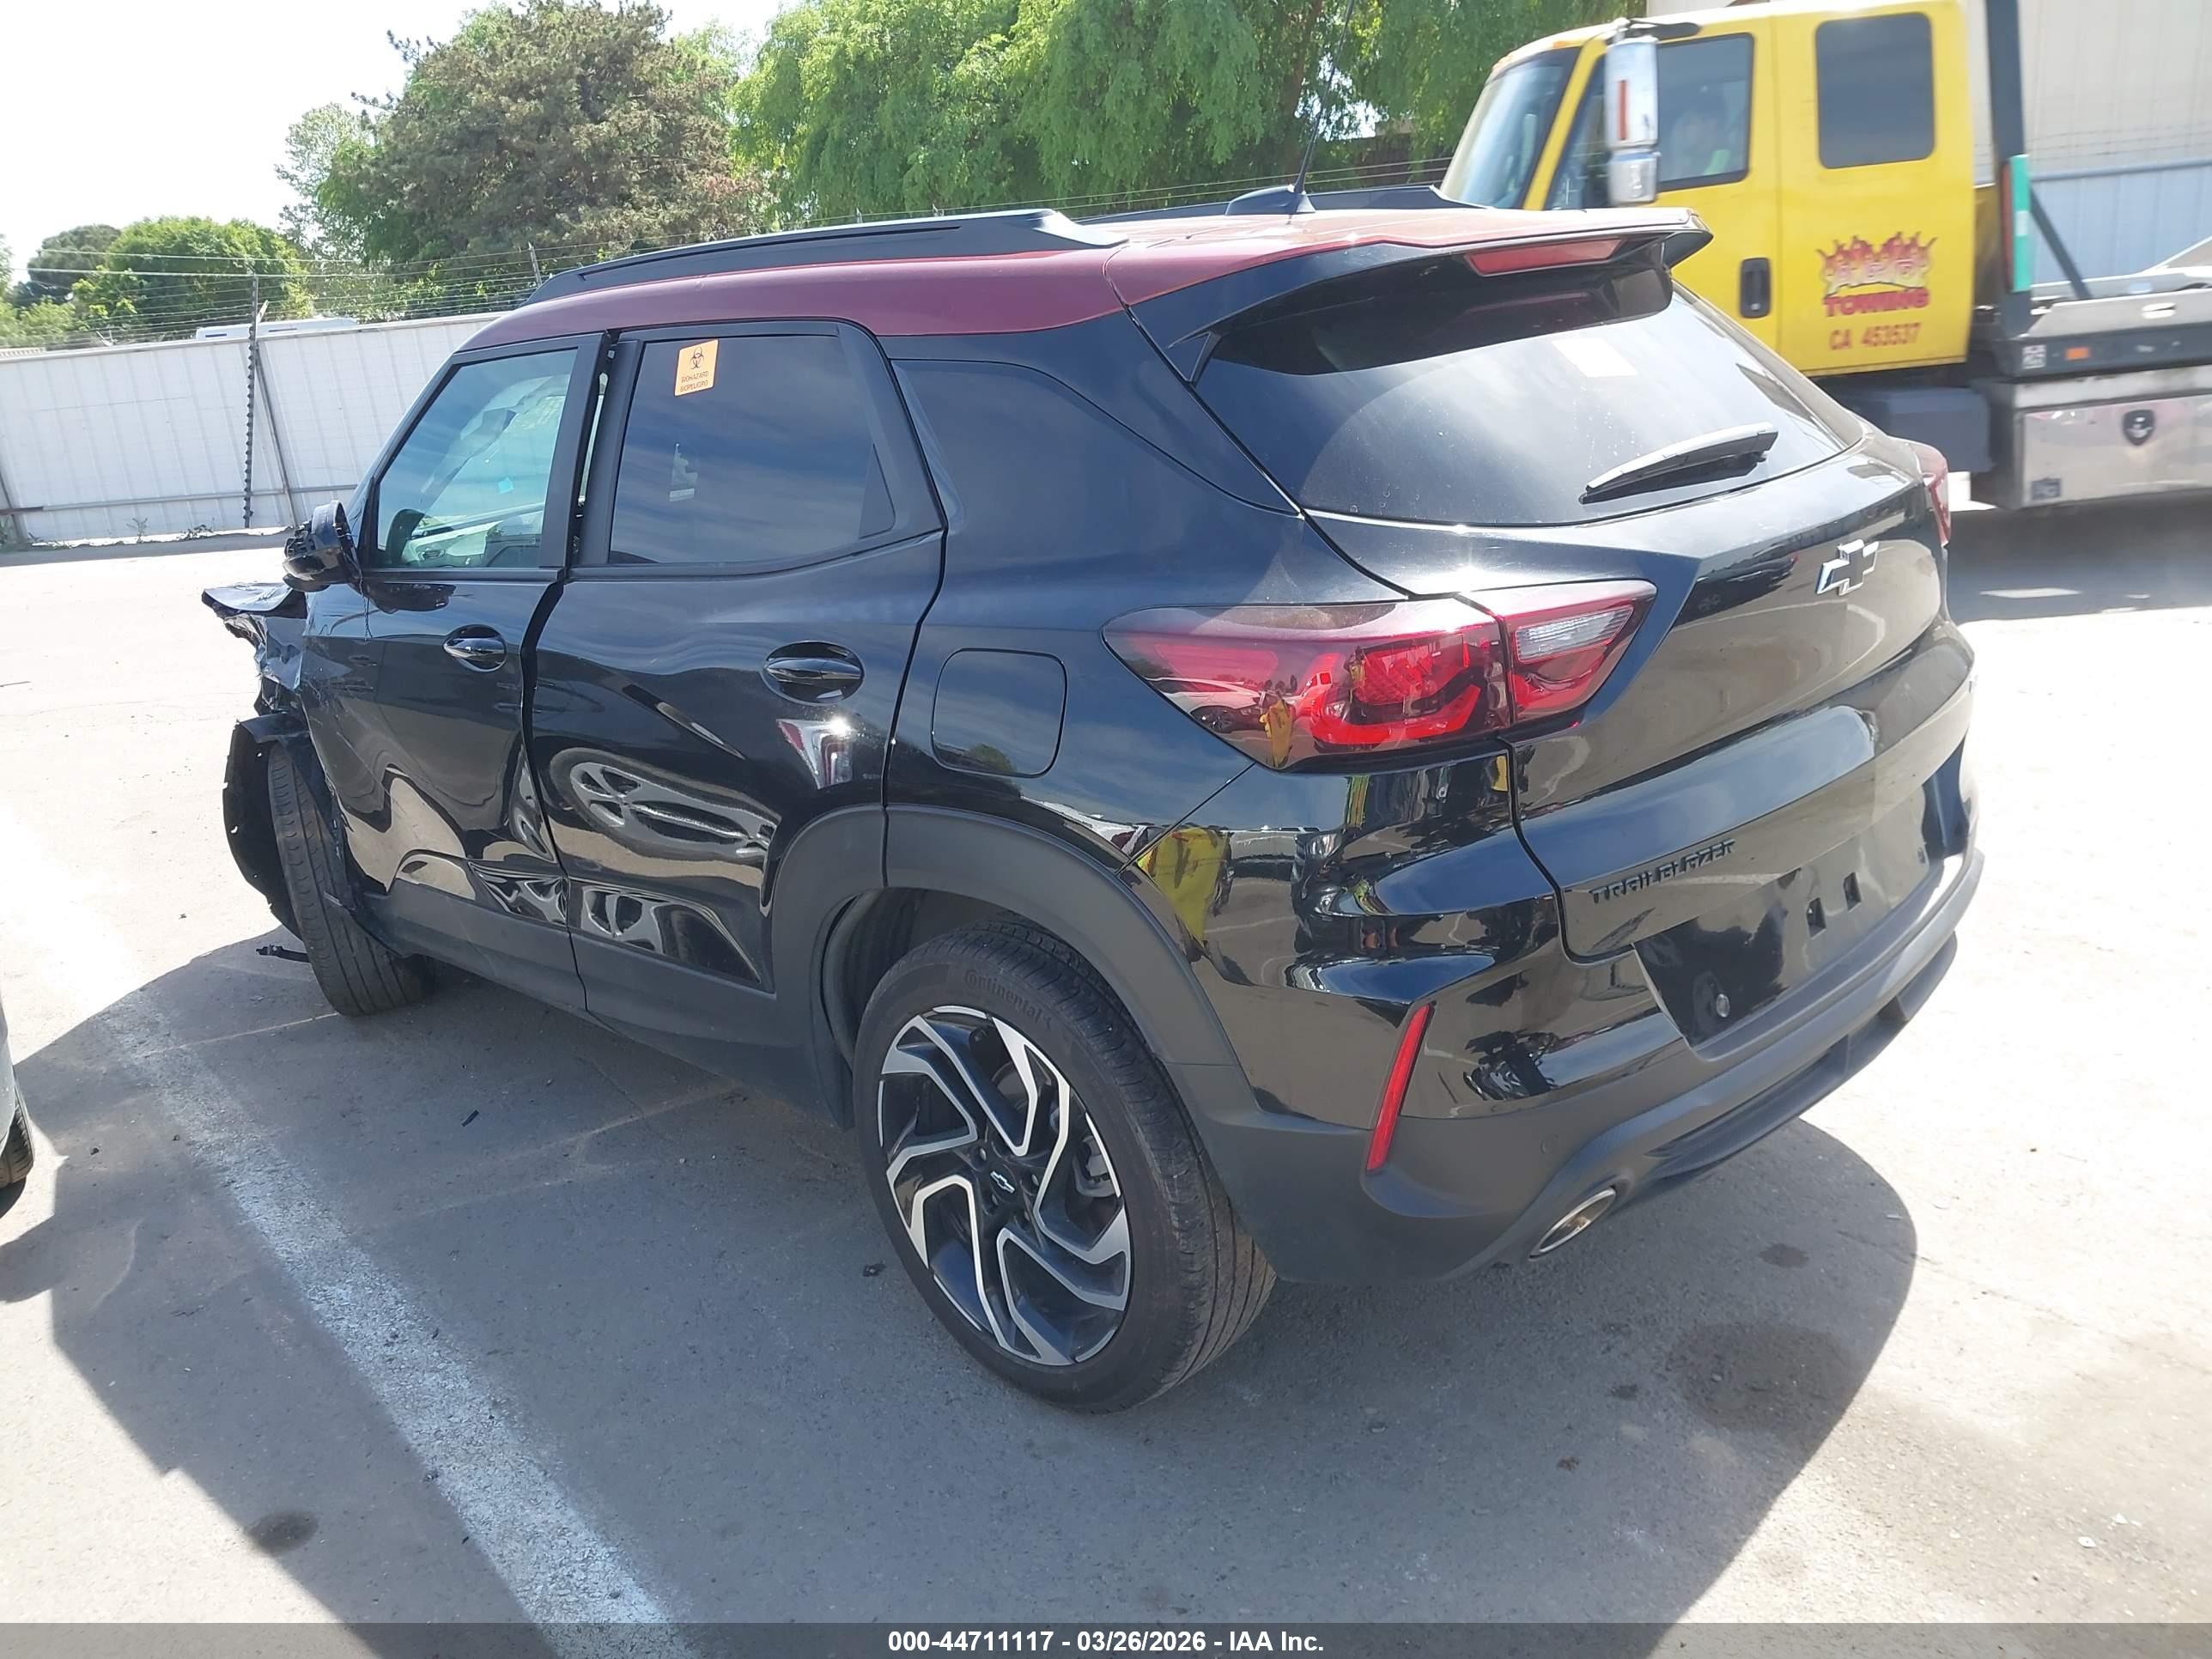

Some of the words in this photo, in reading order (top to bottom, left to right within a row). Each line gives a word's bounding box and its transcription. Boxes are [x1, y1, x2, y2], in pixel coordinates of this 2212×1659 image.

[1822, 288, 1931, 317] TOWING
[1828, 328, 1852, 350] CA
[681, 370, 709, 383] BIOHAZARD
[1589, 838, 1735, 904] TRAILBLAZER
[964, 969, 1047, 1024] Continental
